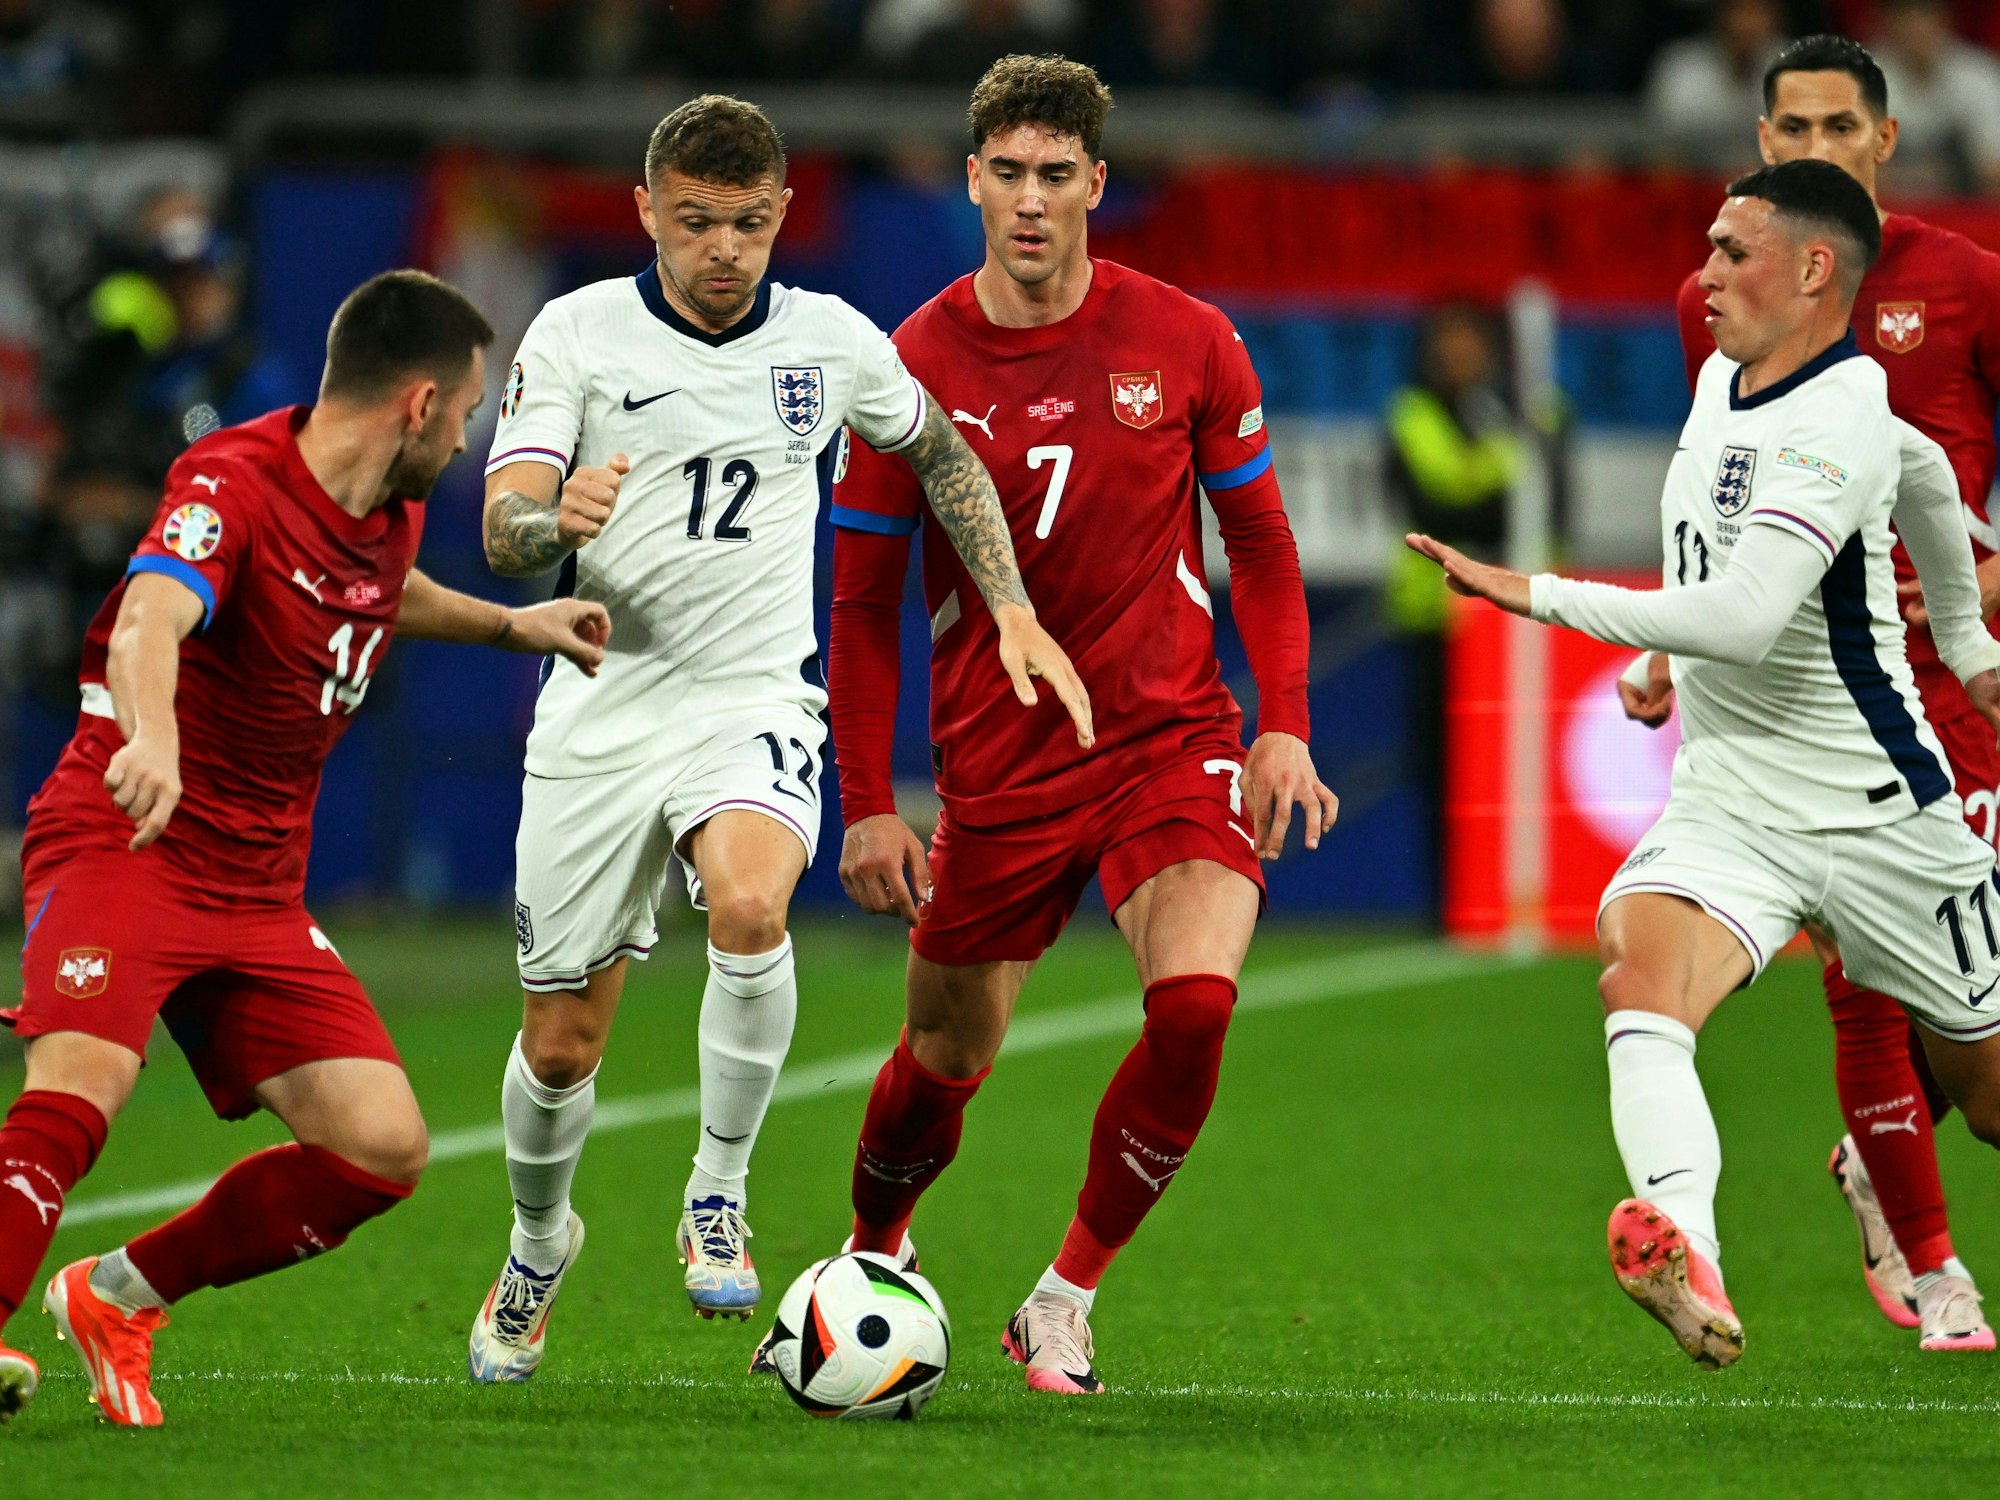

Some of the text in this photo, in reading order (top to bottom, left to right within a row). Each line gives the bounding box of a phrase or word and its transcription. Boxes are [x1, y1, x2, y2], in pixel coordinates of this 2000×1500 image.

[787, 440, 811, 451] SERBIA
[1028, 401, 1074, 417] SRB-ENG
[683, 457, 760, 542] 12
[1027, 445, 1073, 540] 7
[1776, 452, 1848, 482] FOUNDATION
[1674, 520, 1711, 587] 11
[320, 623, 383, 716] 14
[751, 731, 817, 806] 12
[1936, 881, 2000, 977] 11
